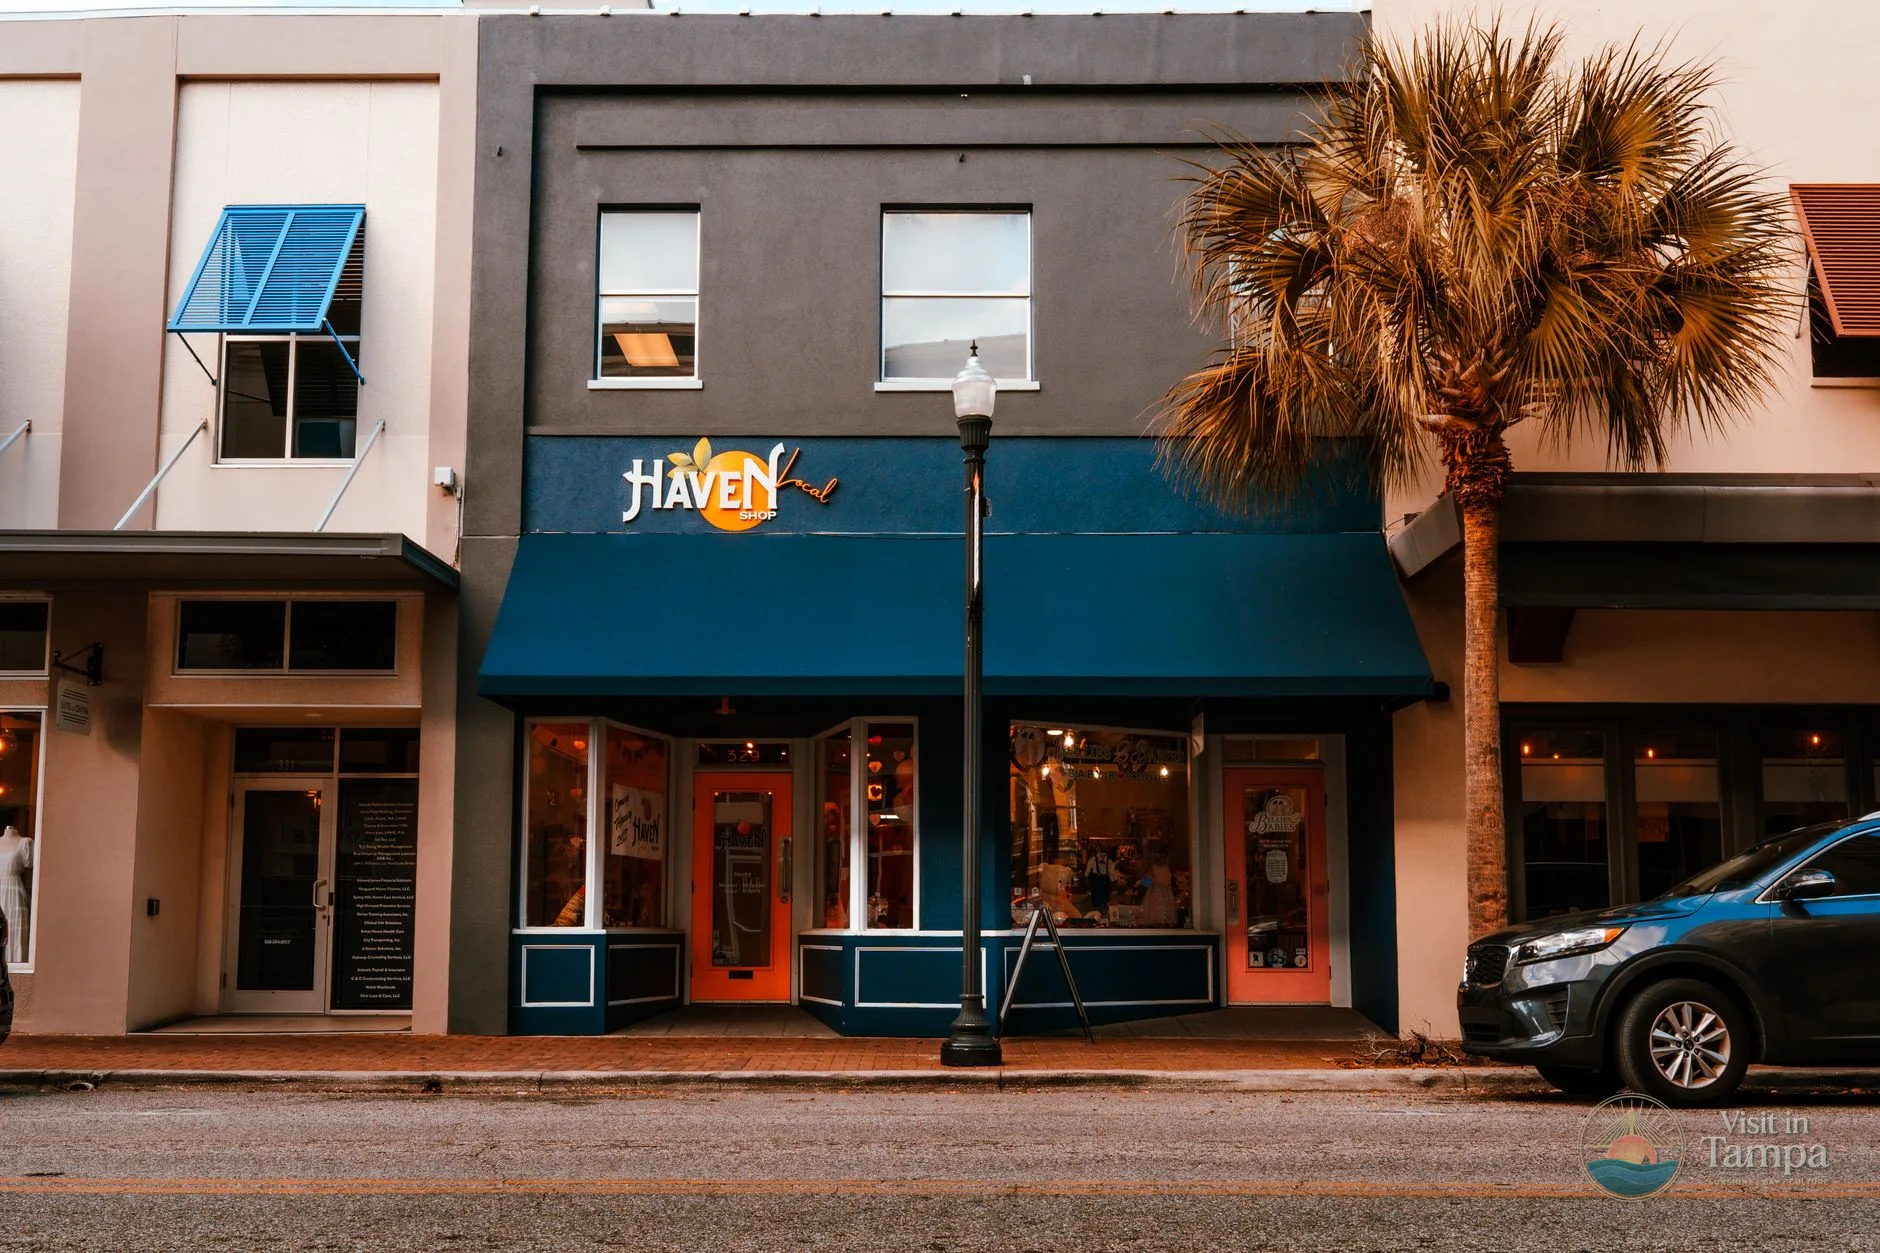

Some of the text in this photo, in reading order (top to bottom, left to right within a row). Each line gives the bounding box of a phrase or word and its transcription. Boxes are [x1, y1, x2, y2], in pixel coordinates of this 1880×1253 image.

[622, 442, 838, 523] HAVEN Local
[739, 511, 777, 520] SHOP
[727, 749, 760, 762] 329
[632, 813, 661, 847] HAVEN
